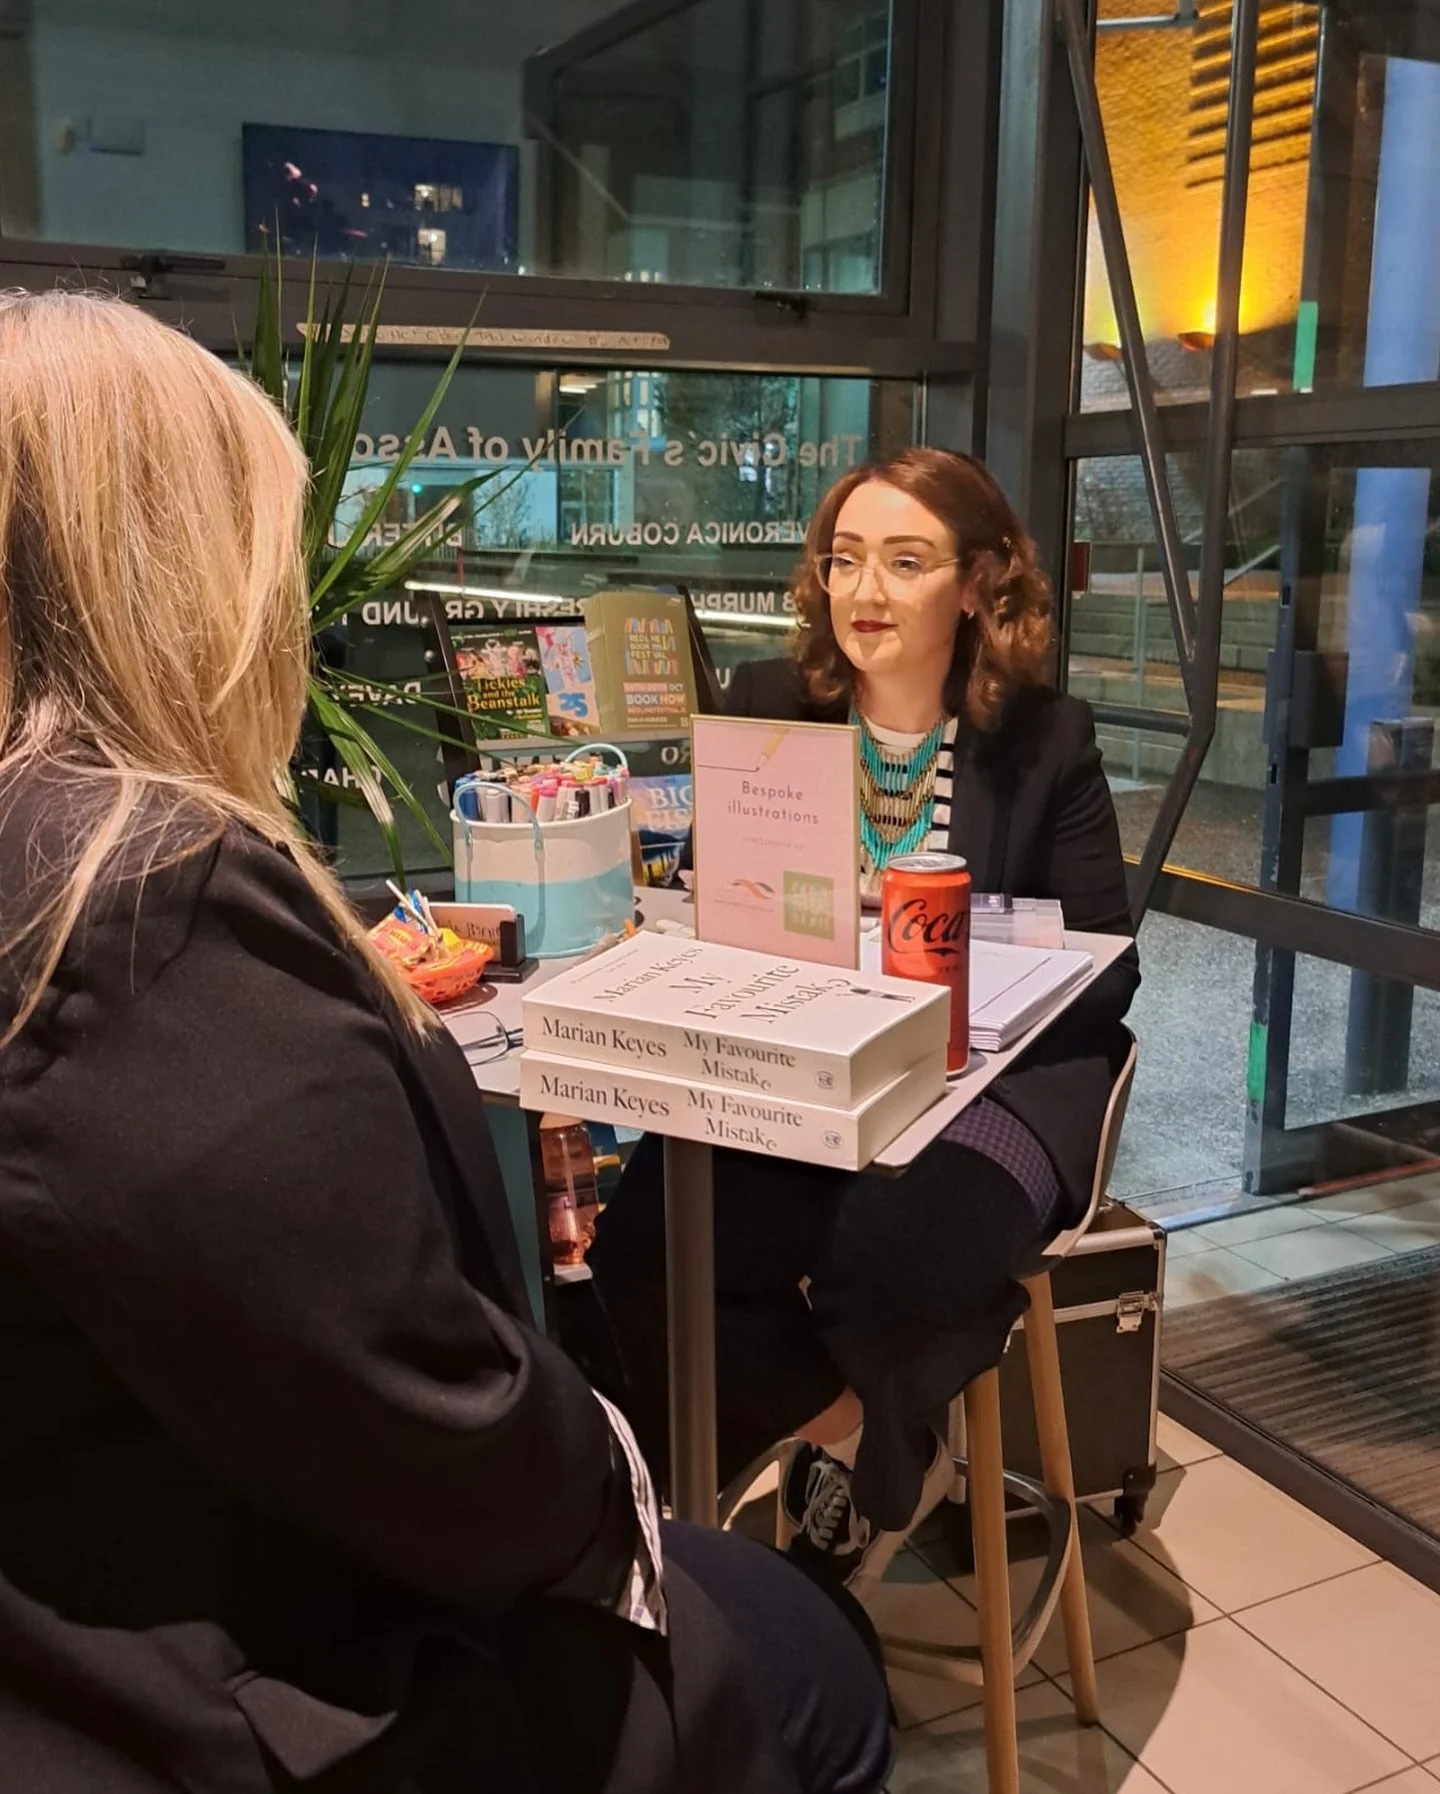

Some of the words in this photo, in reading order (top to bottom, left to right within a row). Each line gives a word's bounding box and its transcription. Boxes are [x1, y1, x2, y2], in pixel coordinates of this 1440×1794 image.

[467, 693, 540, 711] Beanstalk
[626, 694, 659, 705] BOOK
[742, 780, 803, 800] Bespoke
[728, 800, 819, 825] illustrations
[888, 898, 967, 953] Coca
[593, 966, 659, 1003] Marian
[650, 946, 704, 975] Keyes
[668, 970, 733, 995] My
[684, 963, 800, 1019] Favourite
[740, 977, 852, 1024] Mistake
[542, 1016, 606, 1046] Marian
[612, 1028, 667, 1059] Keyes
[683, 1030, 711, 1053] My
[716, 1037, 796, 1068] Favourite
[701, 1057, 772, 1090] Mistake
[541, 1074, 607, 1105] Marian
[612, 1088, 669, 1118] Keyes
[687, 1088, 716, 1113] My
[721, 1094, 803, 1127] Favourite
[705, 1117, 777, 1151] Mistake
